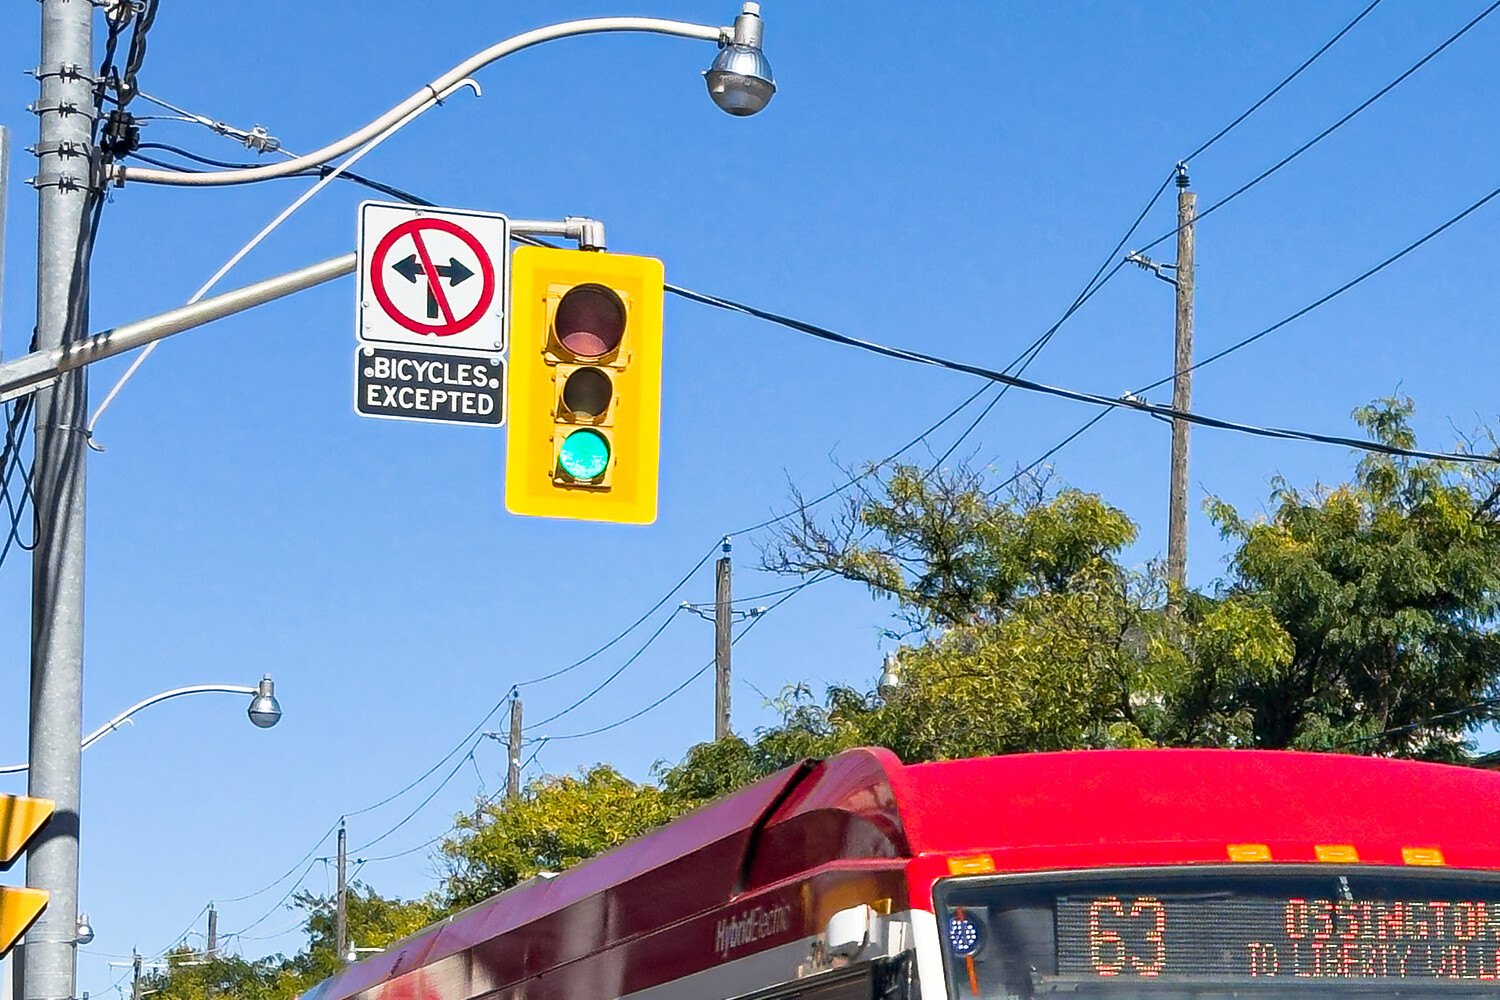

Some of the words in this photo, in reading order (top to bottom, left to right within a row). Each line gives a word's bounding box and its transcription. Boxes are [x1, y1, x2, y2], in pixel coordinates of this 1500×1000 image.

[374, 356, 488, 387] BICYCLES
[367, 384, 494, 415] EXCEPTED
[1089, 896, 1167, 977] 63
[1247, 942, 1279, 977] TO
